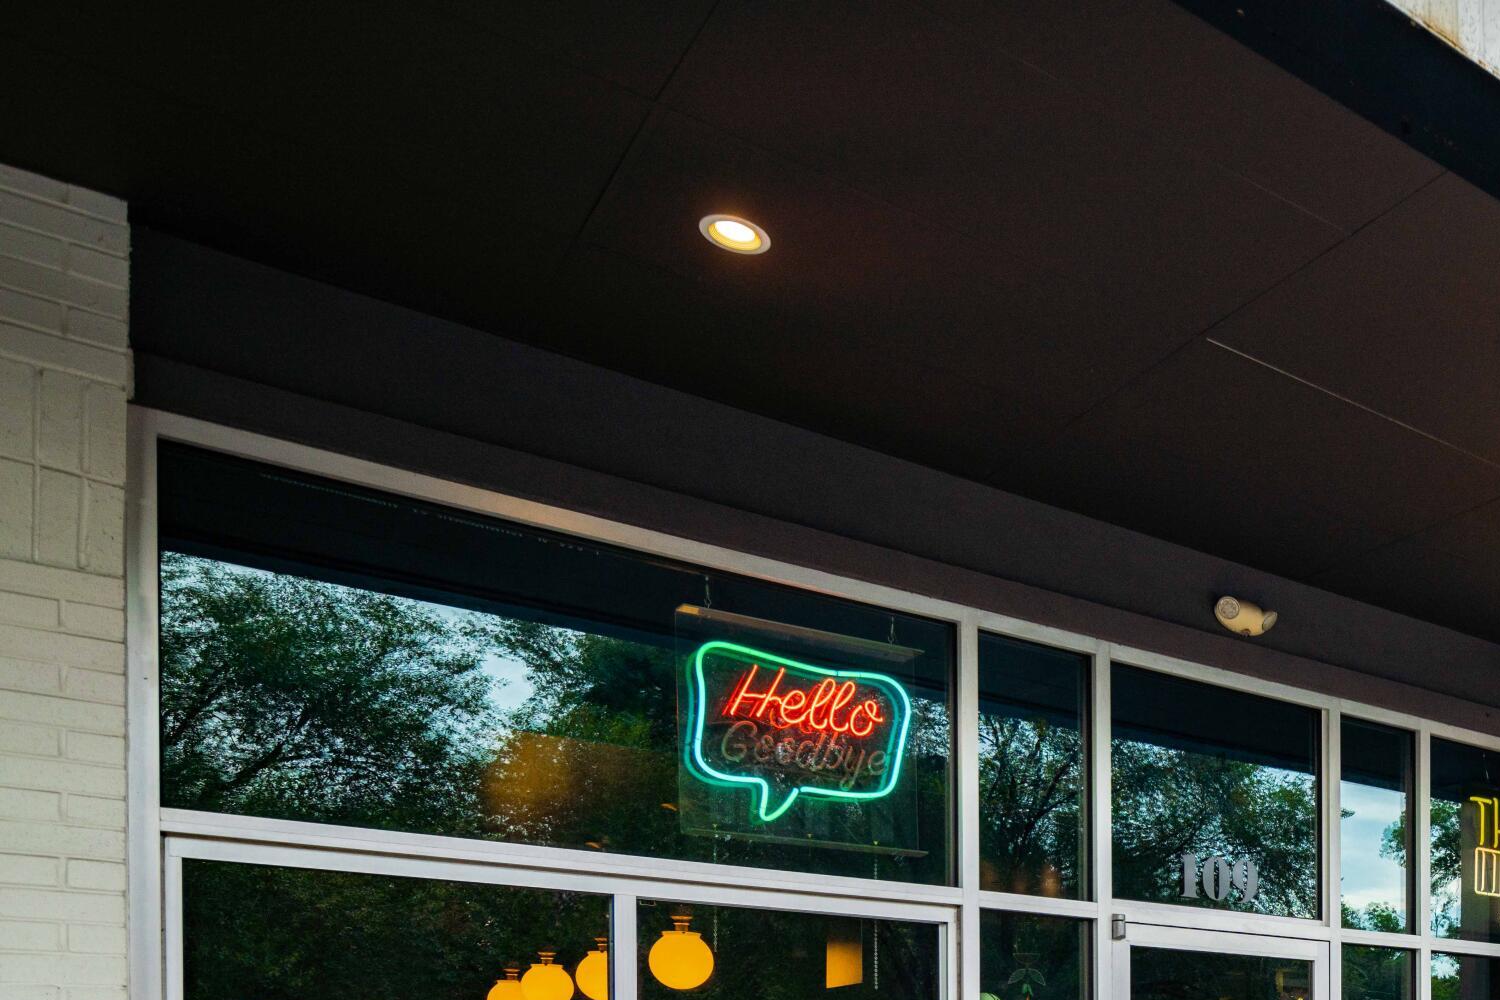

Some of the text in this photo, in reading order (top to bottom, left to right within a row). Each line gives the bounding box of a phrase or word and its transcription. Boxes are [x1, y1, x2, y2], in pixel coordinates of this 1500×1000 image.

[725, 663, 884, 736] Hello
[721, 720, 887, 791] Goodbye
[1180, 853, 1259, 903] 109
